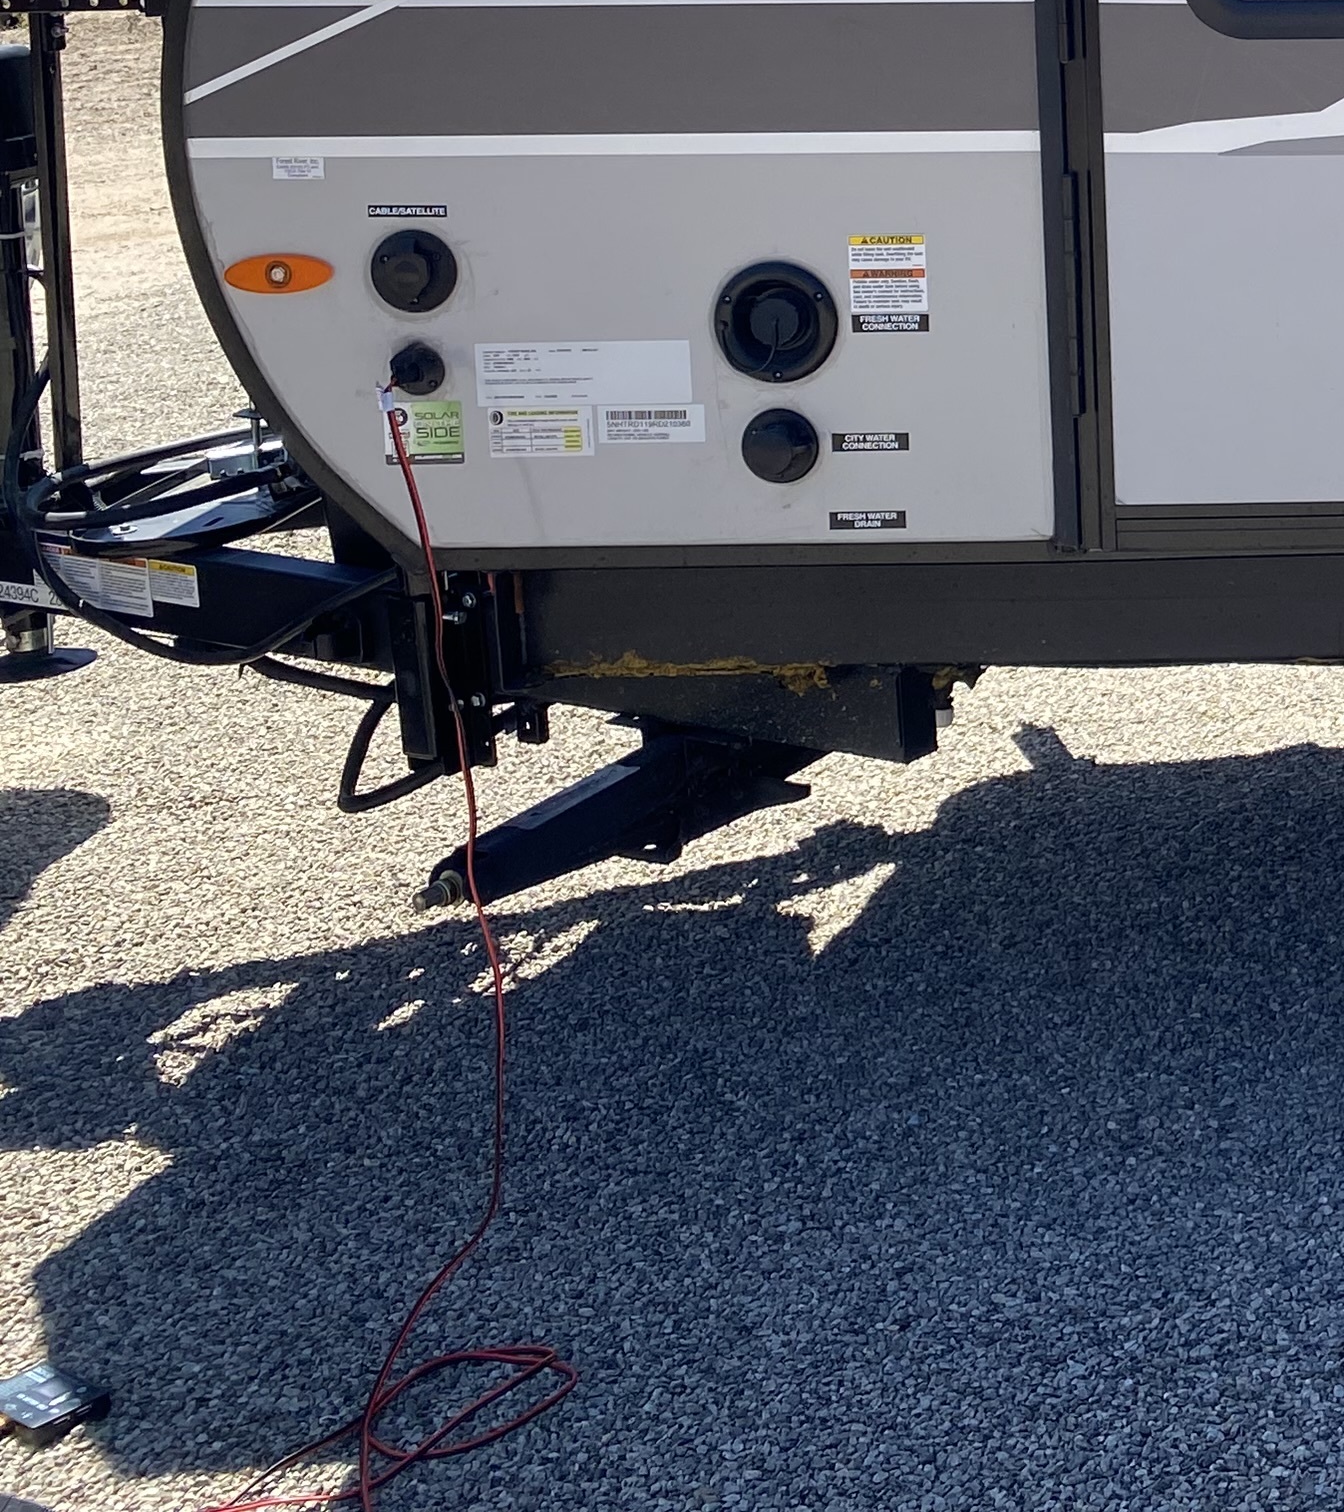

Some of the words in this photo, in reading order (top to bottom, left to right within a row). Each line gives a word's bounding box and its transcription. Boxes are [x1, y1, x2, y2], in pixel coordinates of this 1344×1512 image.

[369, 207, 446, 215] CABLE/SATELLITE
[869, 236, 912, 244] CAUTION
[859, 315, 889, 323] FRESH
[861, 322, 919, 331] CONNECTION
[414, 411, 460, 420] SOLAR
[416, 426, 461, 438] SIDE
[844, 434, 864, 442] CITY
[842, 442, 899, 450] CONNECTION
[837, 512, 866, 521] FRESH
[867, 512, 897, 520] WATER
[854, 520, 882, 528] DRAIN
